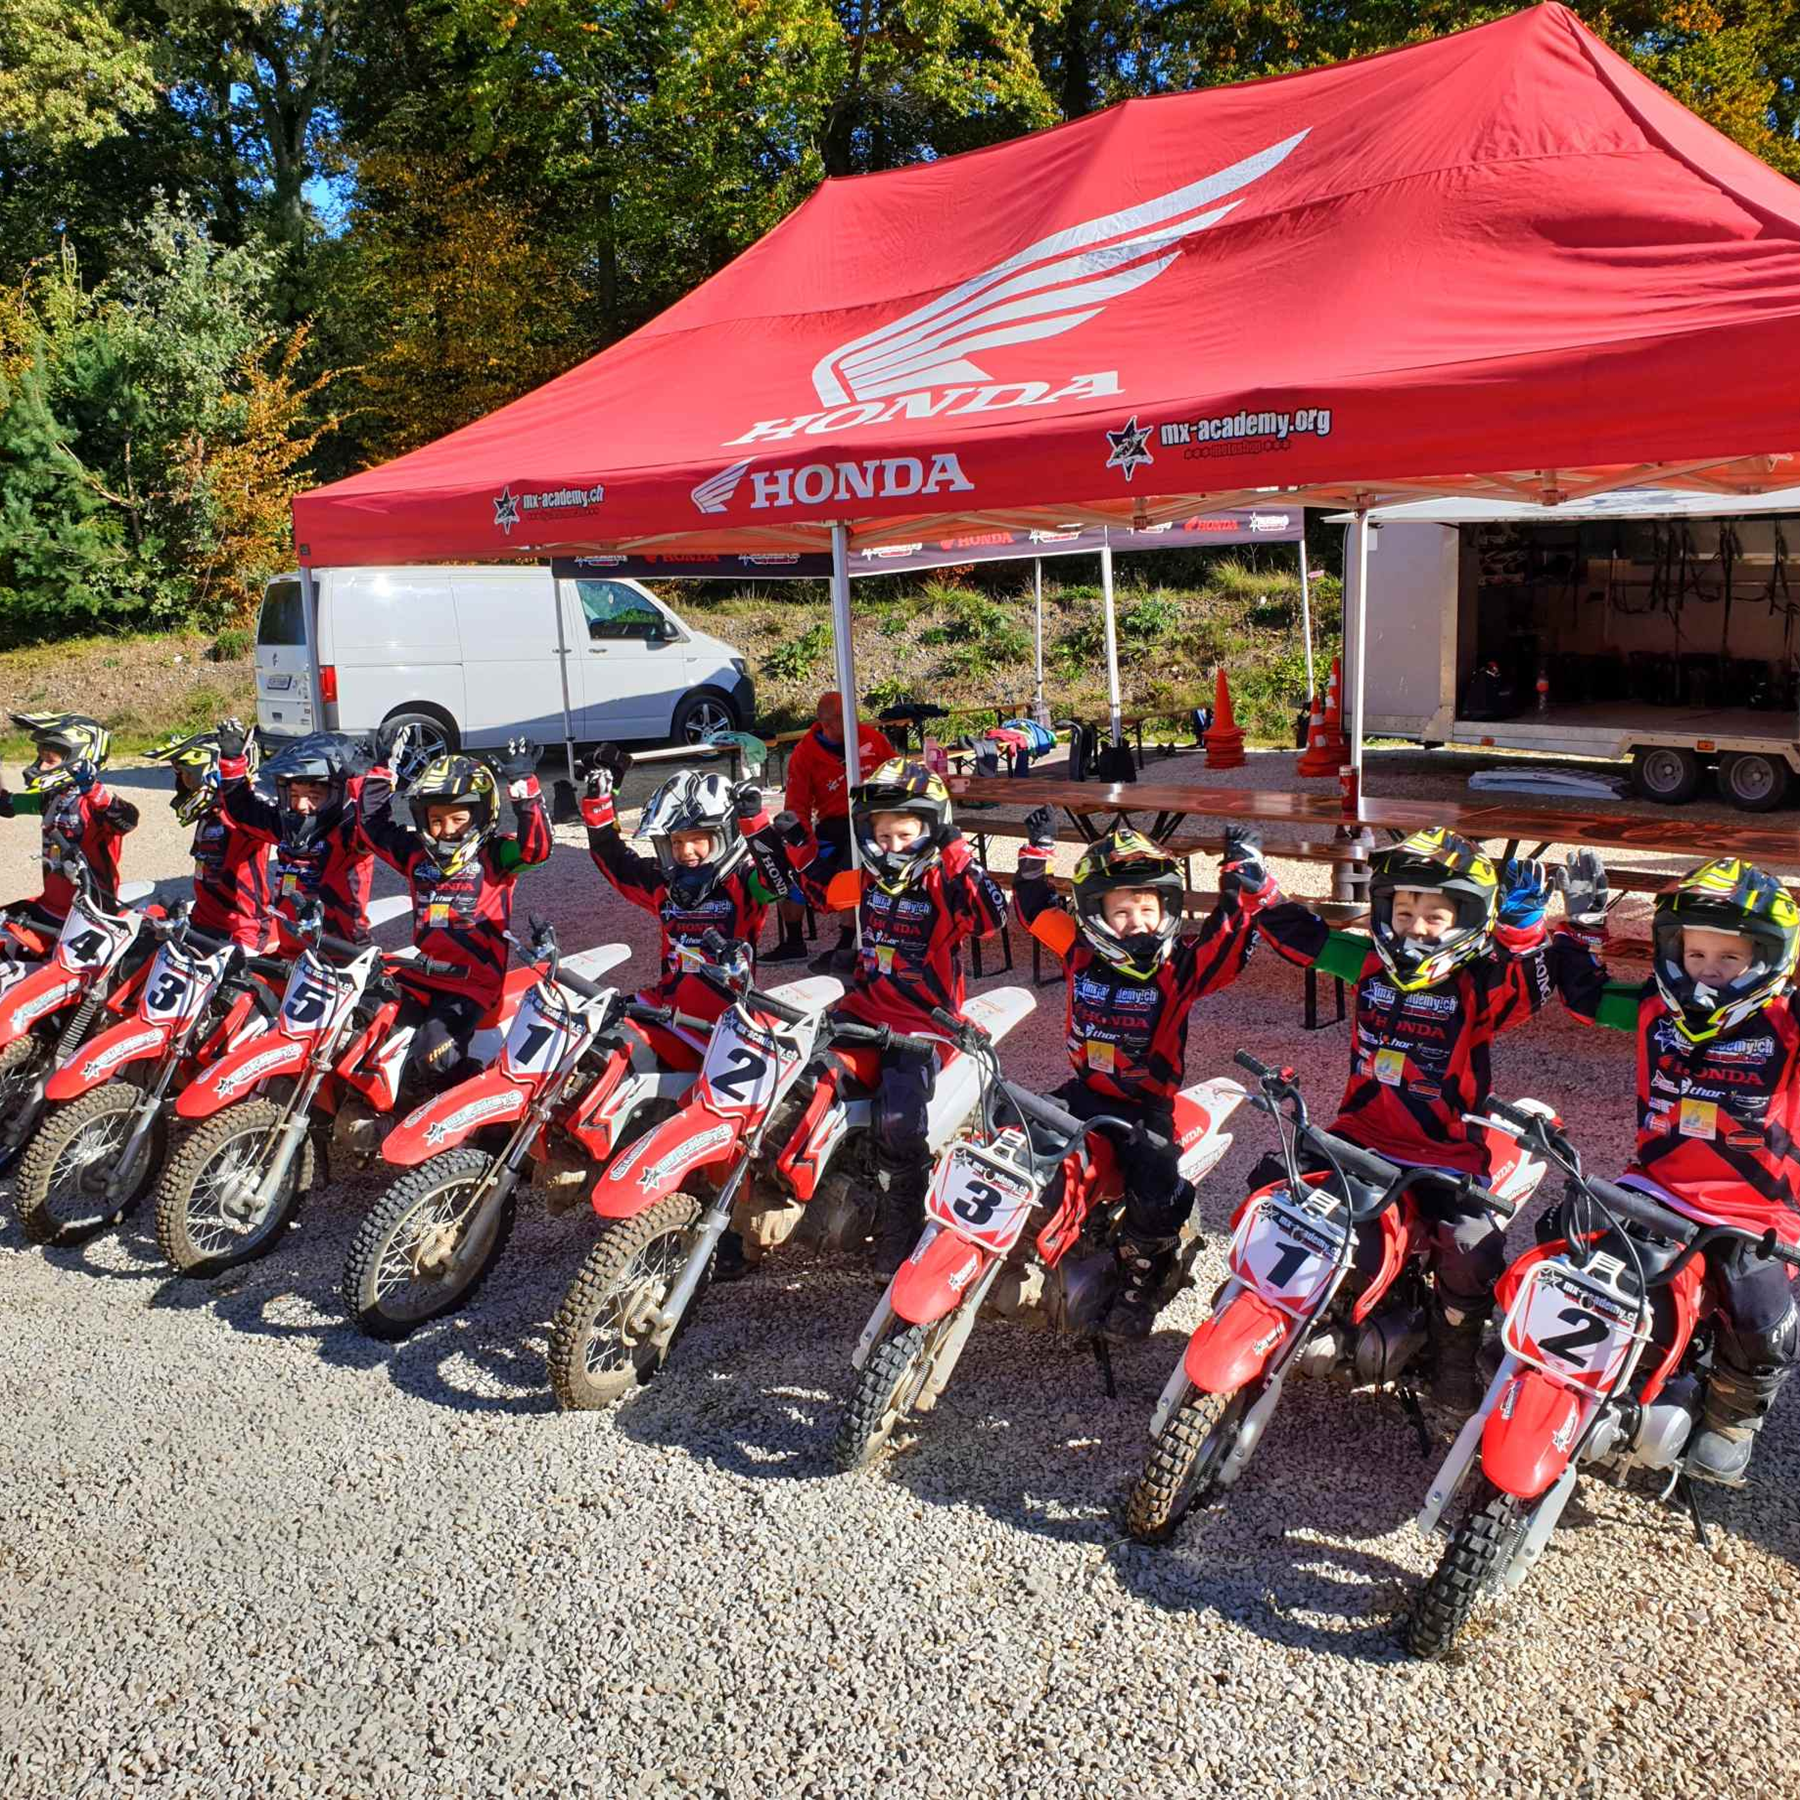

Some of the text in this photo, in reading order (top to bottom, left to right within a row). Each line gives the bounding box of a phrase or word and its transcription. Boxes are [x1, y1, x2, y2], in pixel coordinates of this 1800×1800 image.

[722, 370, 1125, 446] HONDA
[1160, 408, 1332, 445] mx-academy.org
[523, 485, 605, 509] mx-academy.ch
[749, 453, 974, 511] HONDA
[957, 531, 1013, 548] HONDA
[762, 854, 788, 896] HOND
[68, 930, 107, 963] 4
[147, 972, 186, 1011] 3
[285, 982, 334, 1023] 5
[429, 1037, 455, 1063] thor
[514, 1023, 555, 1066] 1
[1093, 1030, 1121, 1041] thor
[710, 1048, 768, 1102] 2
[1690, 1086, 1726, 1098] thor
[953, 1180, 1002, 1225] 3
[1266, 1241, 1311, 1289] 1
[1537, 1308, 1610, 1369] 2
